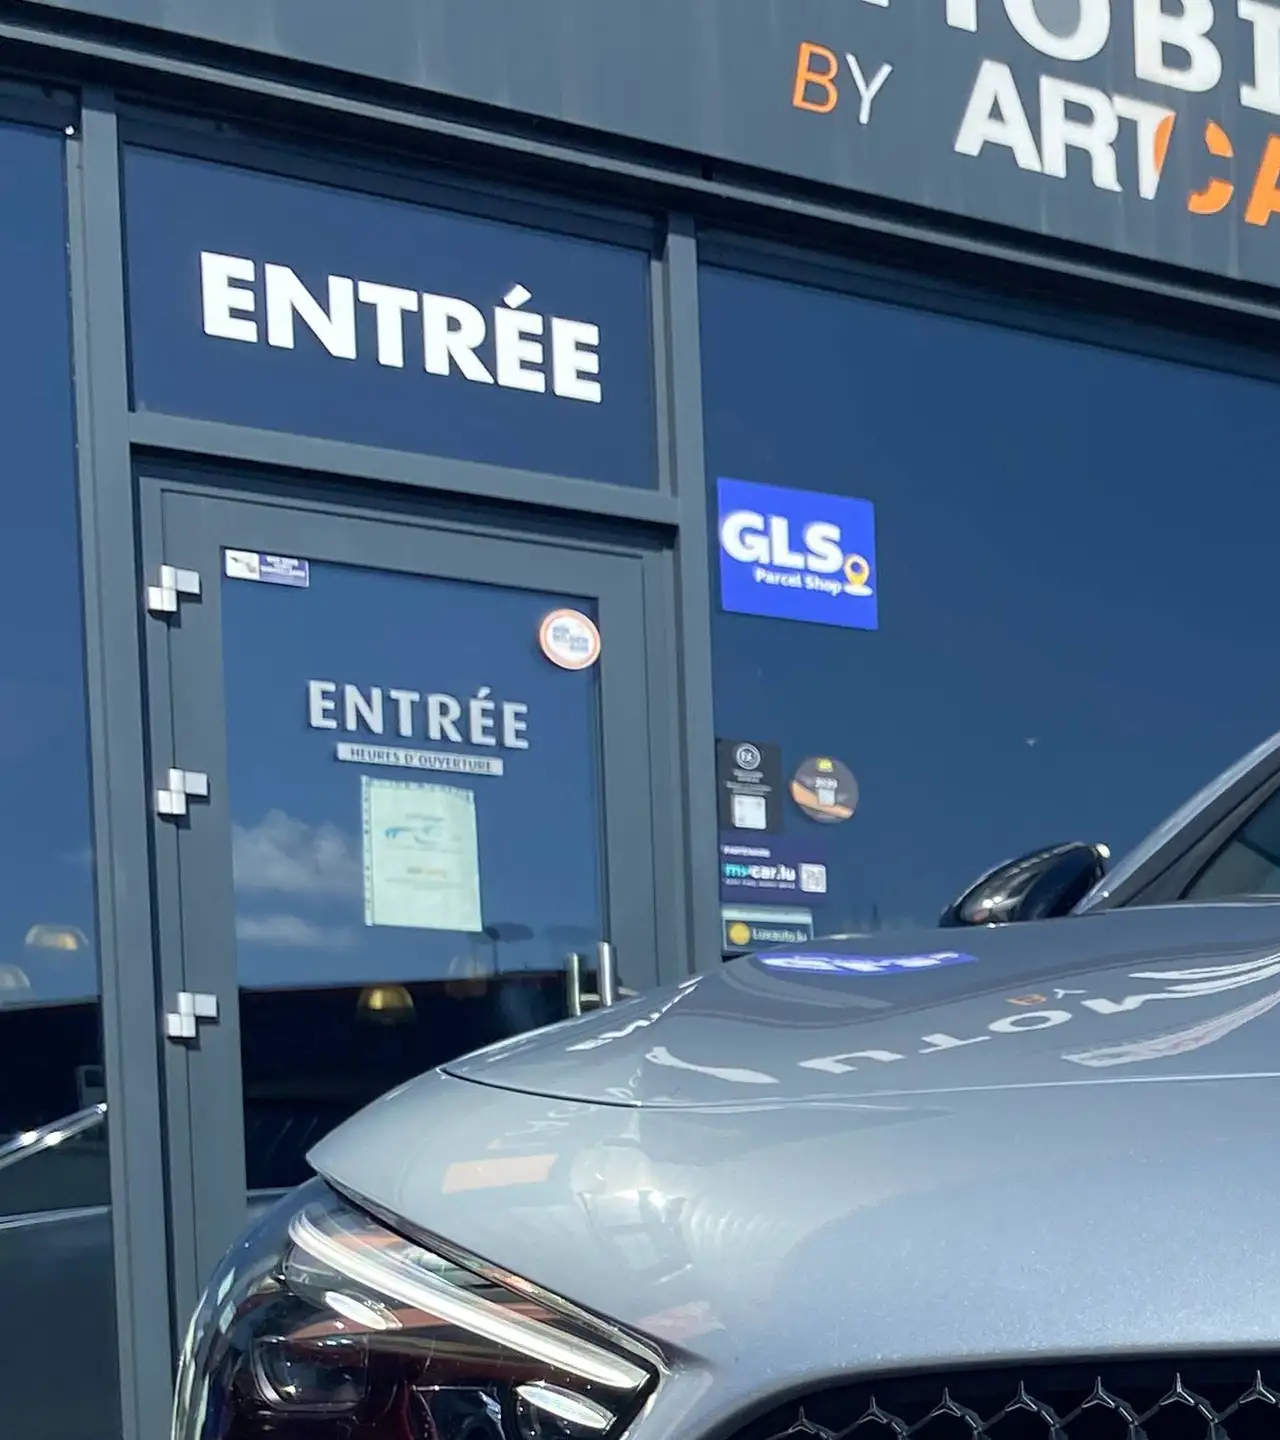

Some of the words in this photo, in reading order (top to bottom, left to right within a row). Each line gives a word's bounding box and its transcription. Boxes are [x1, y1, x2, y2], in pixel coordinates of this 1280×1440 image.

[792, 41, 893, 125] BY
[200, 250, 602, 403] ENTRÉE
[721, 509, 844, 574] GLS
[755, 567, 802, 588] Parcel
[804, 573, 843, 596] Shop
[308, 679, 529, 749] ENTRÉE
[350, 747, 400, 763] HEURES
[404, 752, 493, 772] D'OUVERTURE
